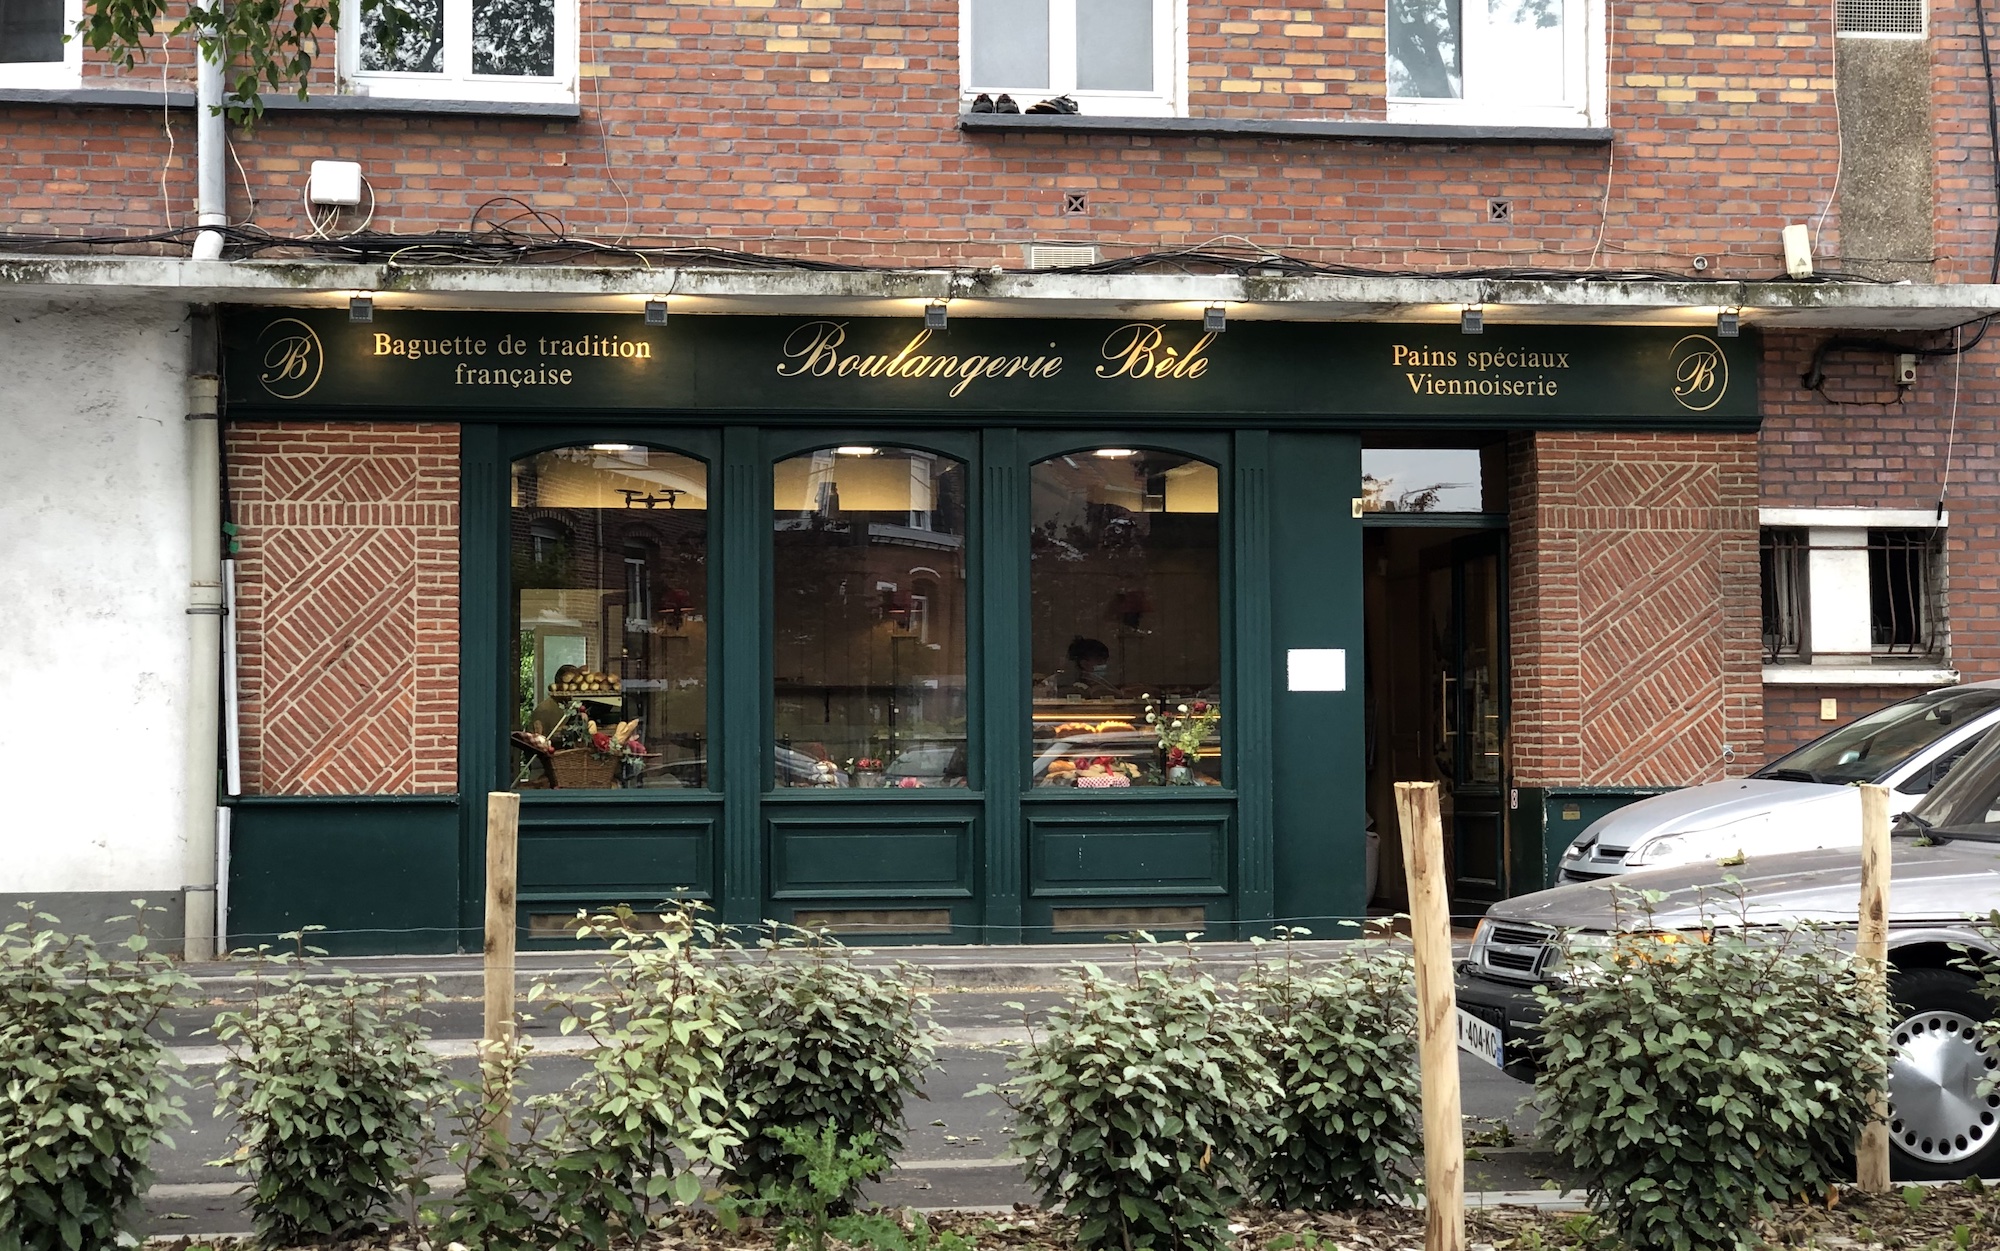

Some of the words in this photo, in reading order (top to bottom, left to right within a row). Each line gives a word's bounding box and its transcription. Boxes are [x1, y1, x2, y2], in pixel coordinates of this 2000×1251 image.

[261, 334, 312, 383] B
[373, 332, 487, 361] Baguette
[497, 333, 527, 356] de
[538, 334, 652, 359] tradition
[776, 320, 1063, 398] Boulangerie
[1095, 322, 1218, 379] Bèle
[1392, 344, 1458, 368] Pains
[1467, 346, 1570, 373] spéciaux
[454, 362, 573, 388] française
[1405, 372, 1558, 397] Viennoiserie
[1674, 349, 1718, 396] B
